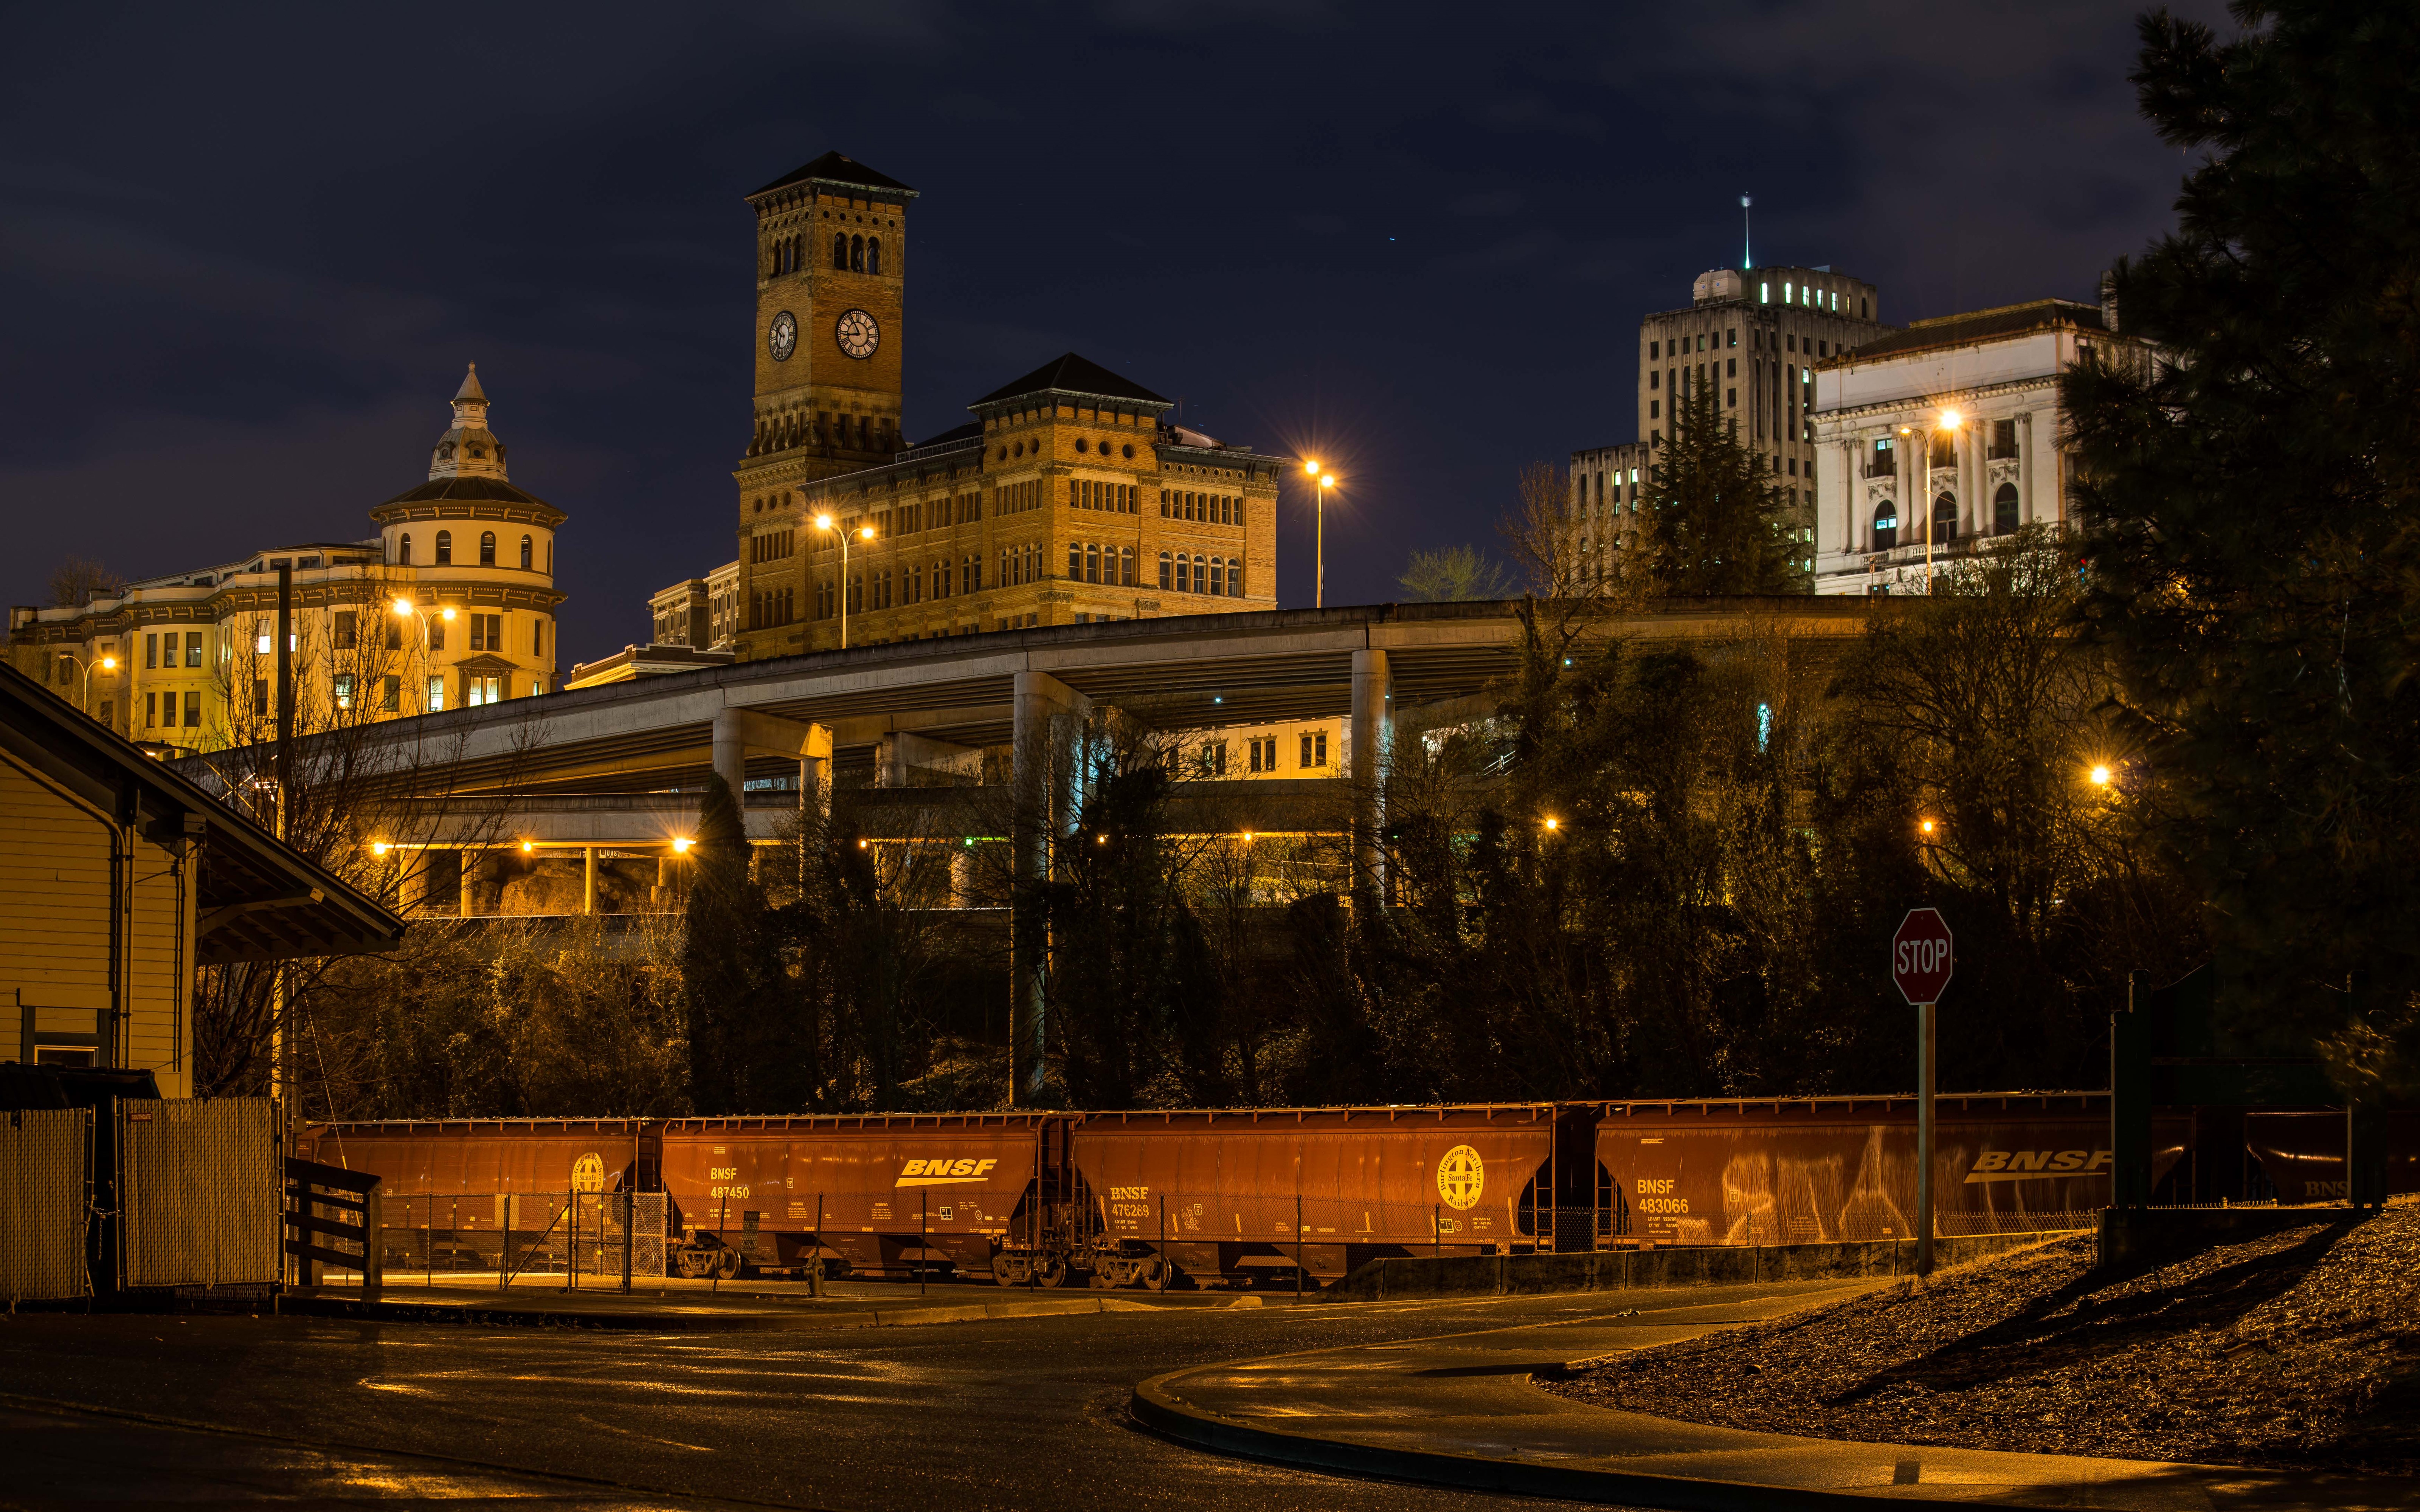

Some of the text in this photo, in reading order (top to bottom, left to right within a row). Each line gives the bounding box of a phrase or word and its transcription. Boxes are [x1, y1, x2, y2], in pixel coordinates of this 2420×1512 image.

[1897, 939, 1947, 974] STOP
[901, 1159, 998, 1176] BNSF
[1972, 1150, 2112, 1170] BNSF
[574, 1153, 602, 1188] Burlington Northern
[711, 1168, 737, 1180] BNSF
[1440, 1148, 1481, 1191] Burlington Northern
[711, 1187, 749, 1199] 487450
[1110, 1187, 1149, 1200] BNSF
[1638, 1179, 1674, 1194] BNSF
[2305, 1181, 2347, 1197] BNS
[1448, 1194, 1476, 1207] Railway
[1639, 1198, 1689, 1214] 483066
[1112, 1204, 1150, 1217] 476289
